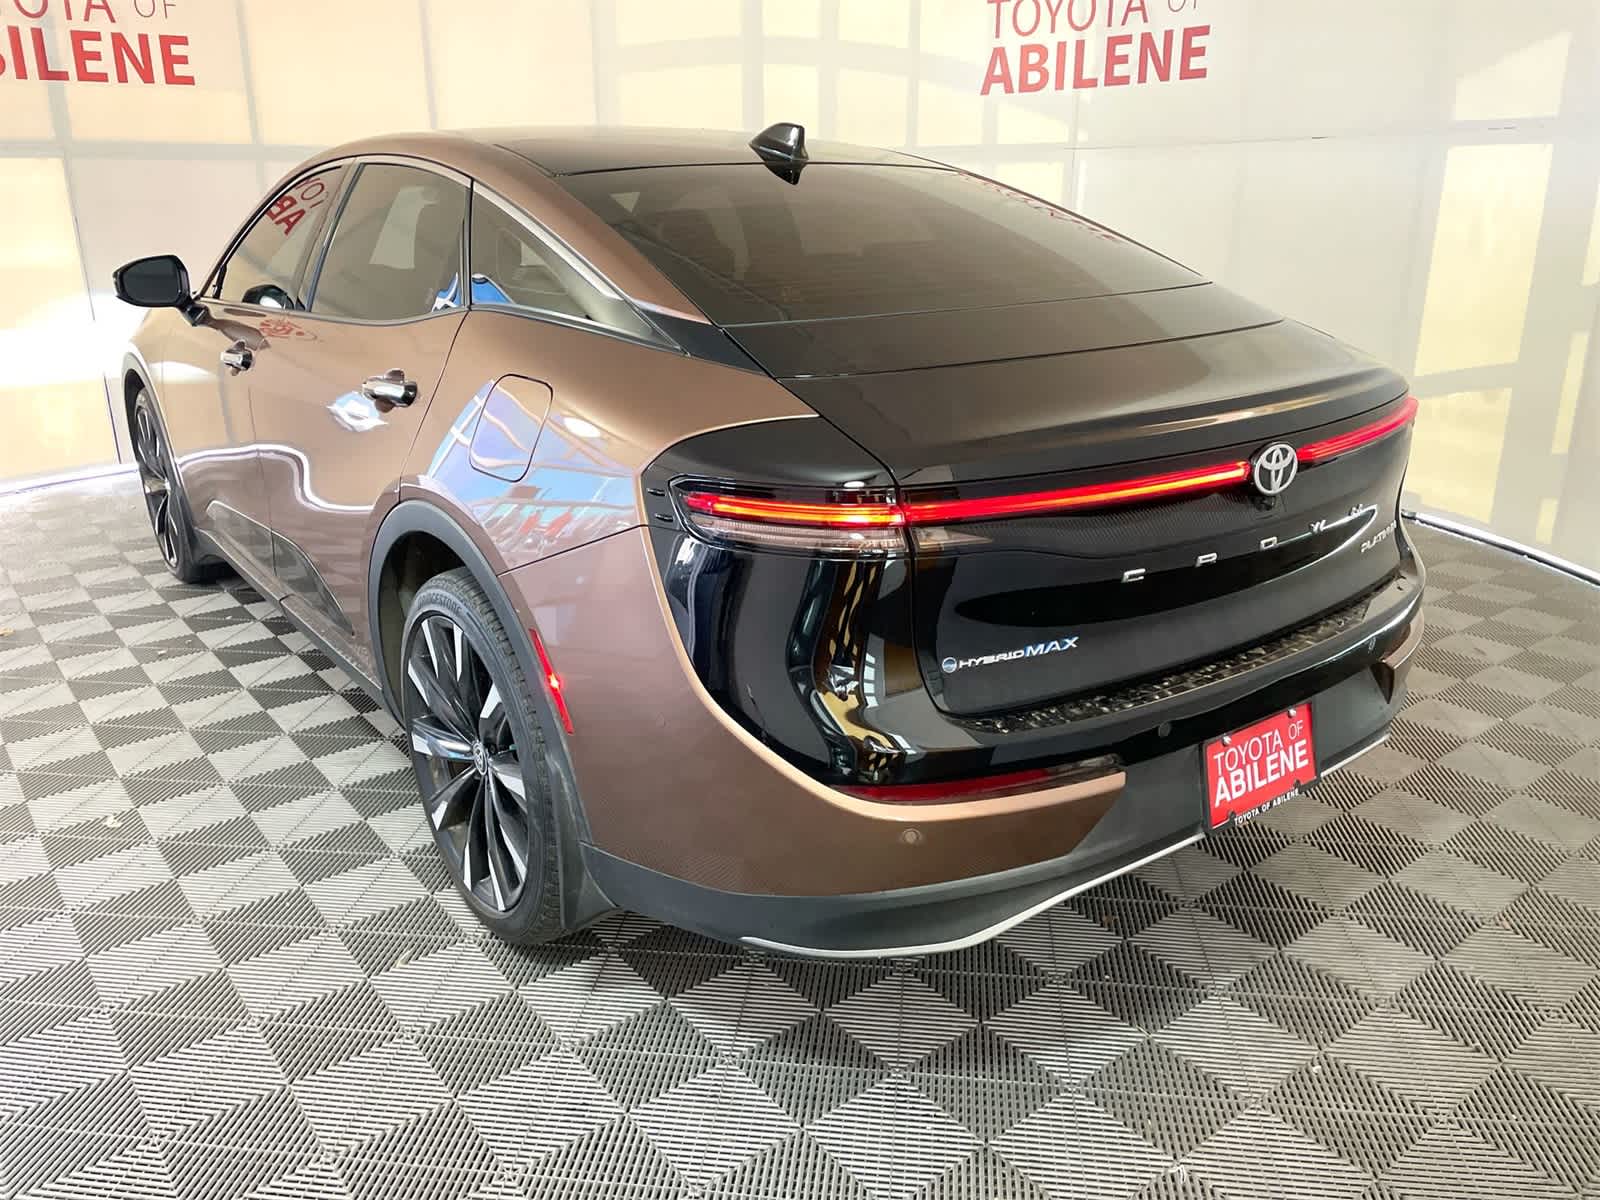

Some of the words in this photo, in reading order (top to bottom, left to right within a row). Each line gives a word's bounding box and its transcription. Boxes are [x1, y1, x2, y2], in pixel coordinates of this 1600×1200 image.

[0, 25, 195, 86] ILENE
[980, 25, 1210, 96] ABILENE
[1213, 728, 1284, 777] TOYOTA
[1288, 720, 1303, 740] OF
[1215, 739, 1309, 808] ABILENE
[1234, 807, 1260, 825] TOYOTA
